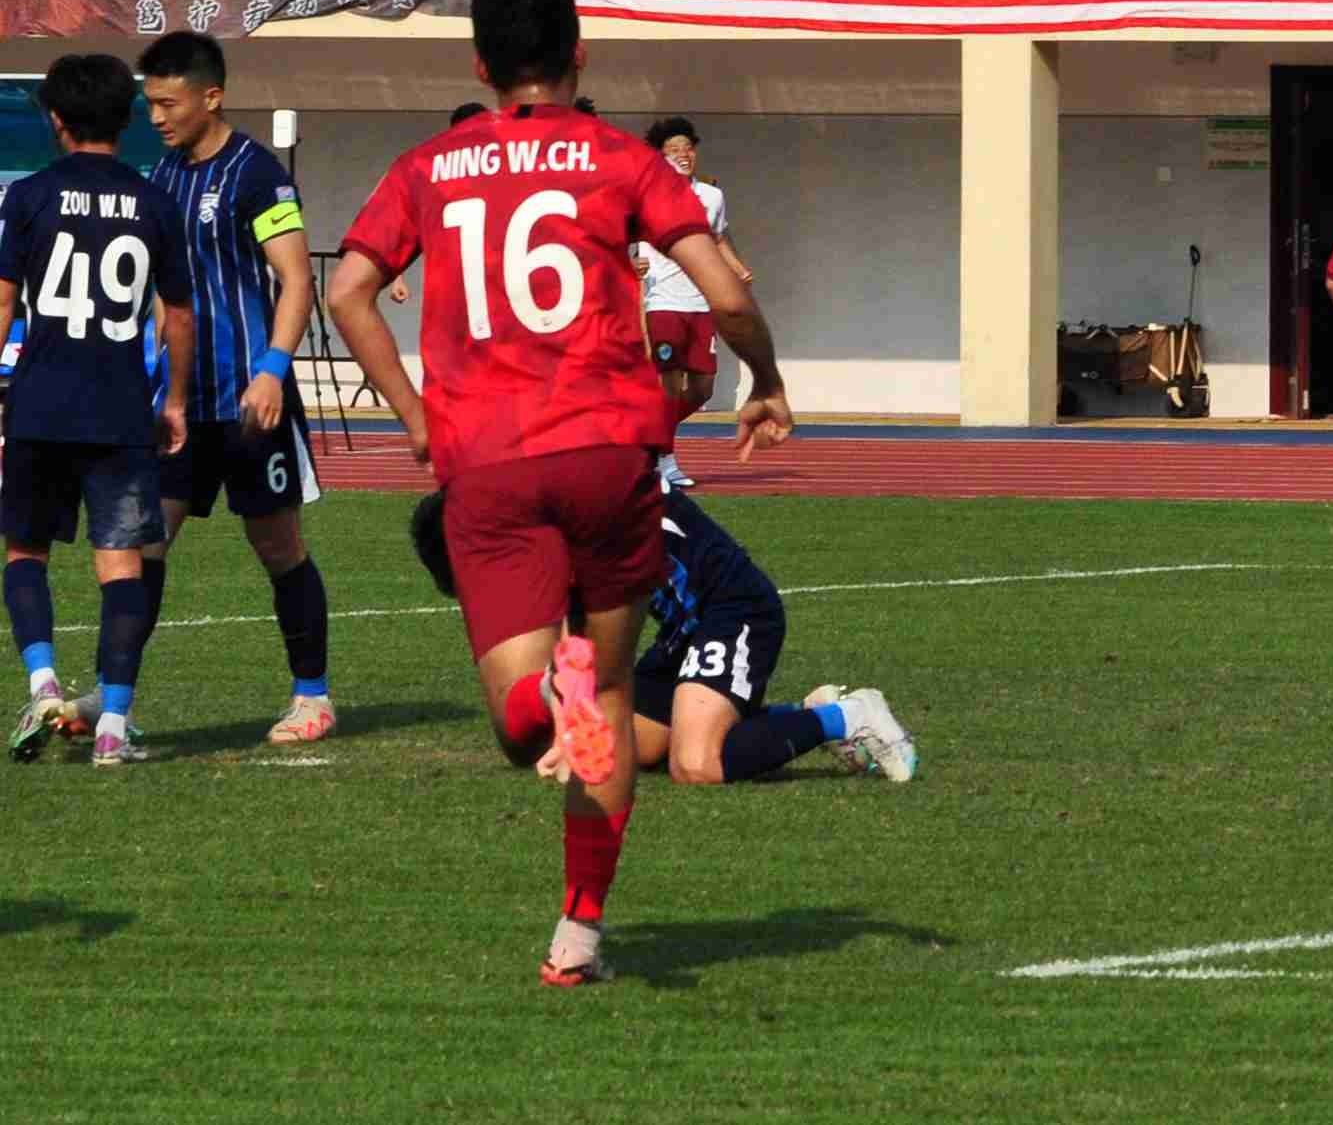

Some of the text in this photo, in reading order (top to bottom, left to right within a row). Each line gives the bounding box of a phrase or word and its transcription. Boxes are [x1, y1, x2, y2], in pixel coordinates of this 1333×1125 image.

[431, 139, 597, 184] NING W.CH.
[60, 190, 140, 221] ZOU W.W.
[443, 190, 585, 340] 16
[37, 232, 151, 342] 49
[266, 452, 287, 494] 6
[678, 641, 727, 678] 43
